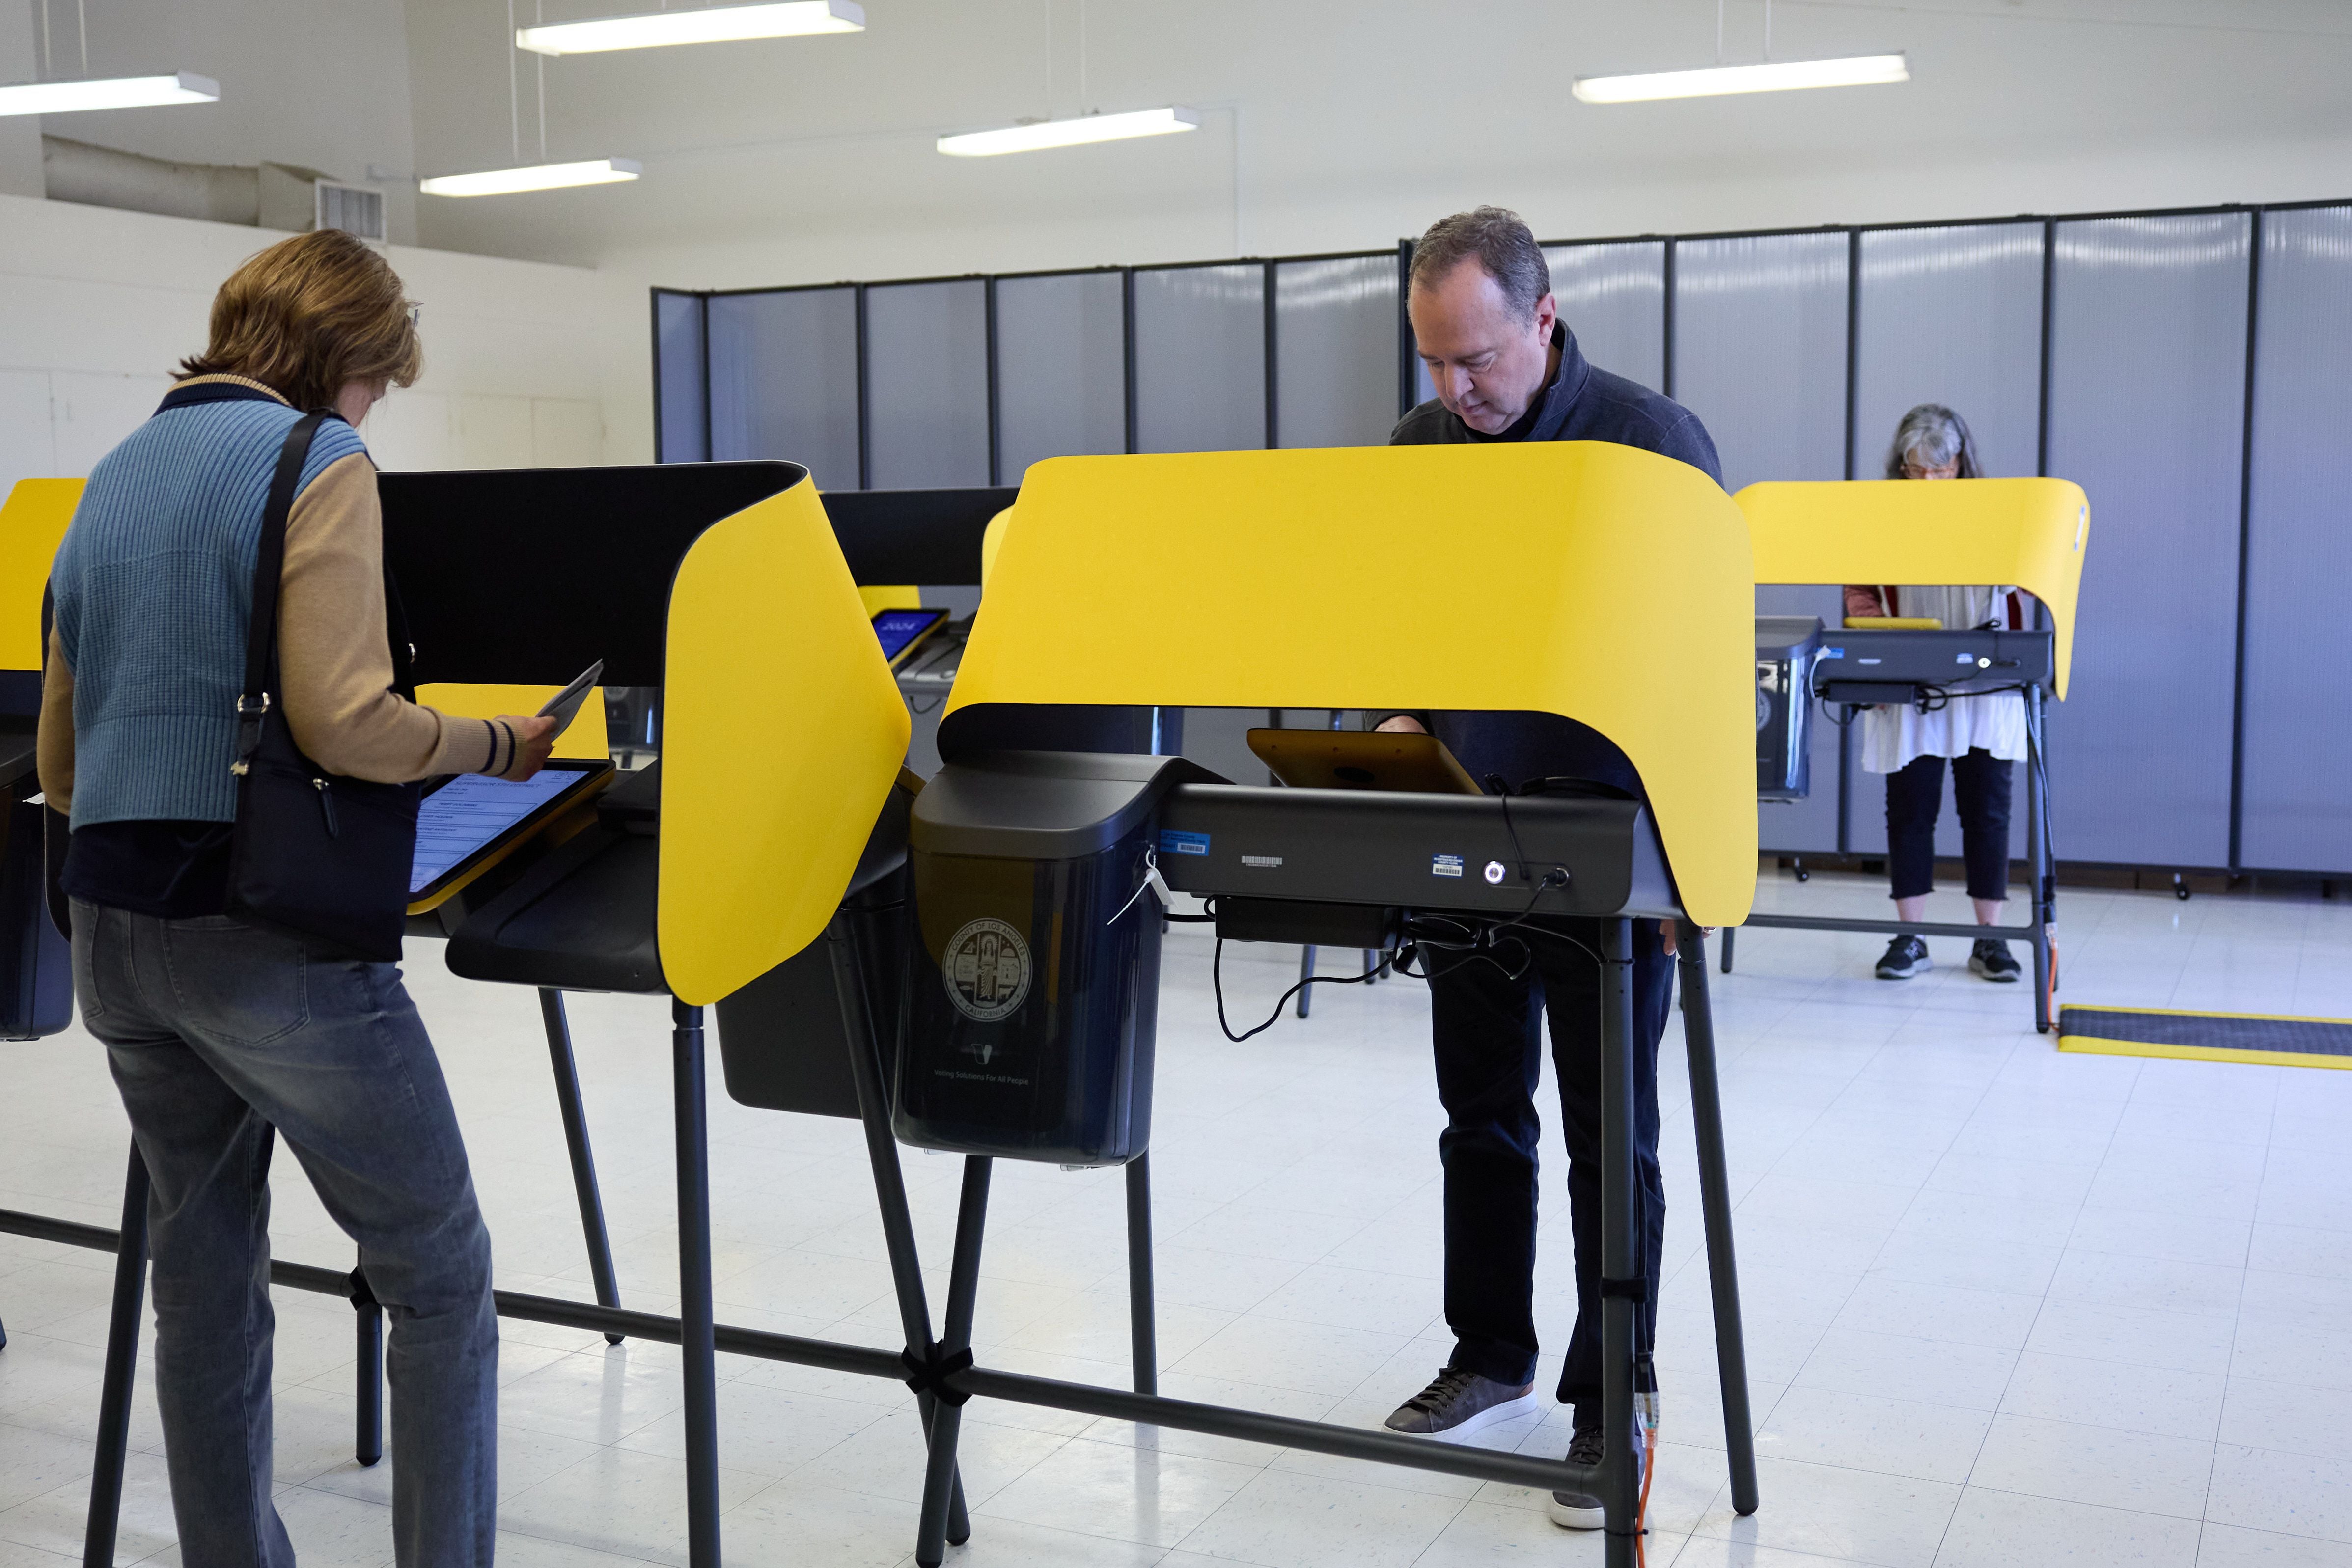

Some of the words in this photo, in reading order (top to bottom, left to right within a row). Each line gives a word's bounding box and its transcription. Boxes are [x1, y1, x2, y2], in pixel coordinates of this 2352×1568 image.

[952, 926, 973, 951] COUNTY
[1002, 929, 1026, 956] ANGELES
[965, 1005, 1006, 1018] CALIFORNIA
[934, 1069, 954, 1079] Voting
[956, 1071, 985, 1081] Solutions
[1007, 1077, 1029, 1086] People
